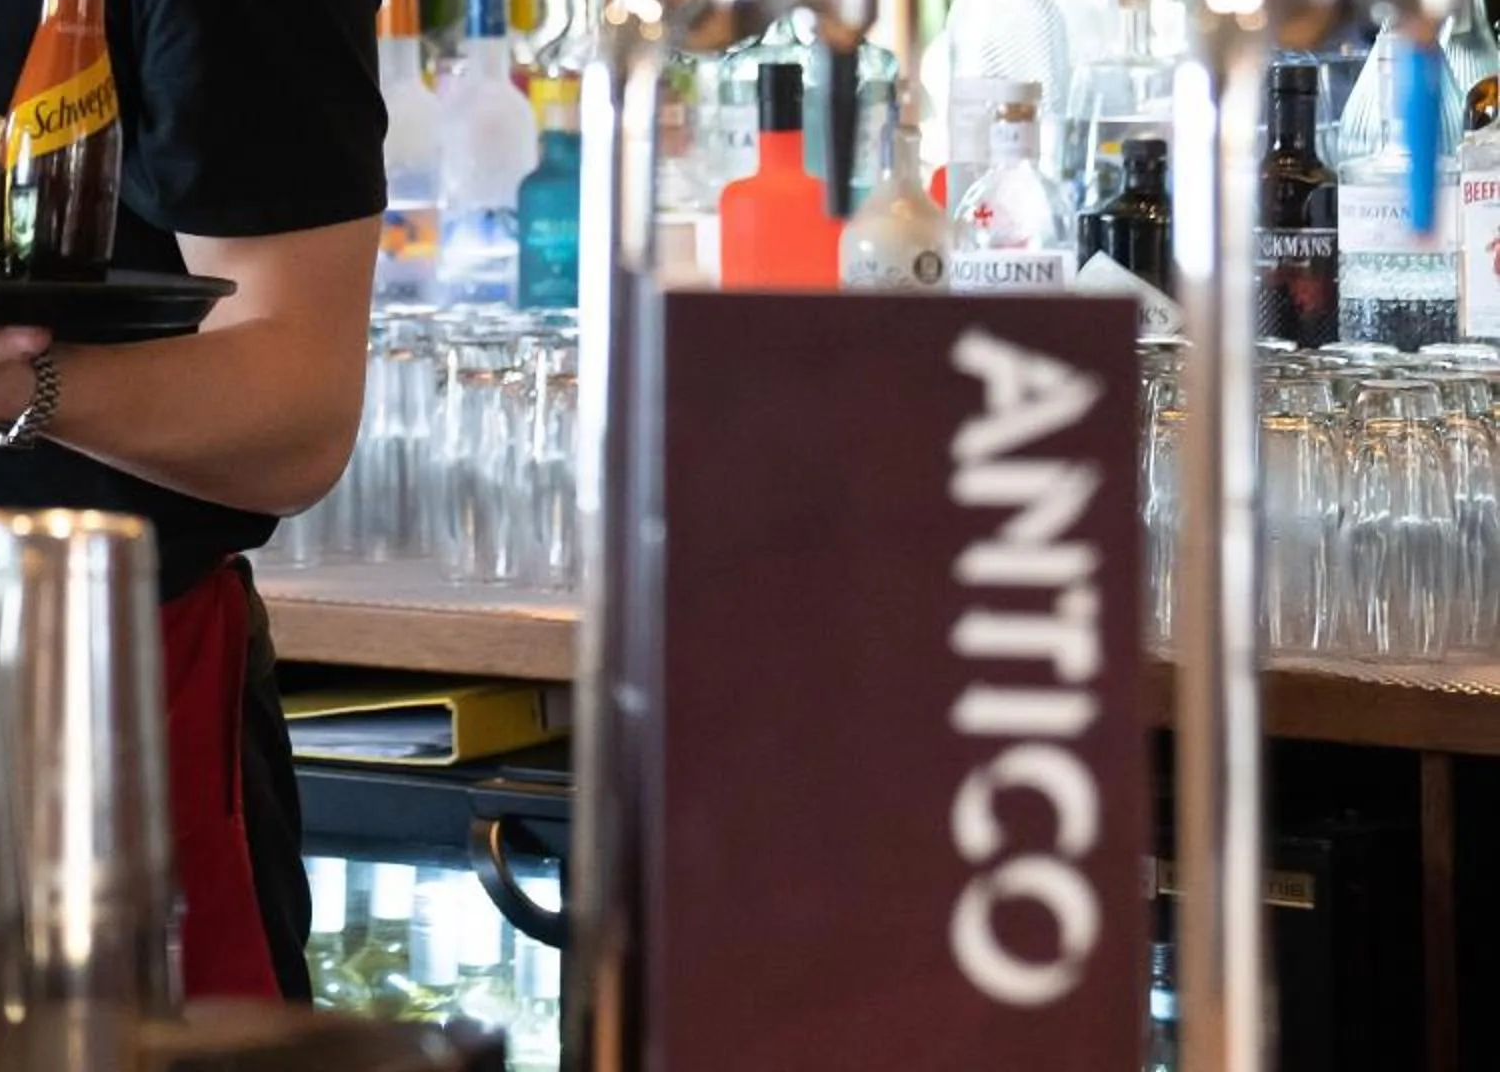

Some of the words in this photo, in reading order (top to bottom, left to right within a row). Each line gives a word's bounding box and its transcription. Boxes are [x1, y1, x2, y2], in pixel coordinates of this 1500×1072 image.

[30, 75, 114, 141] Schwepp
[1463, 180, 1500, 205] BEEF
[1257, 234, 1332, 257] CKMANS
[950, 329, 1102, 1009] ANTICO
